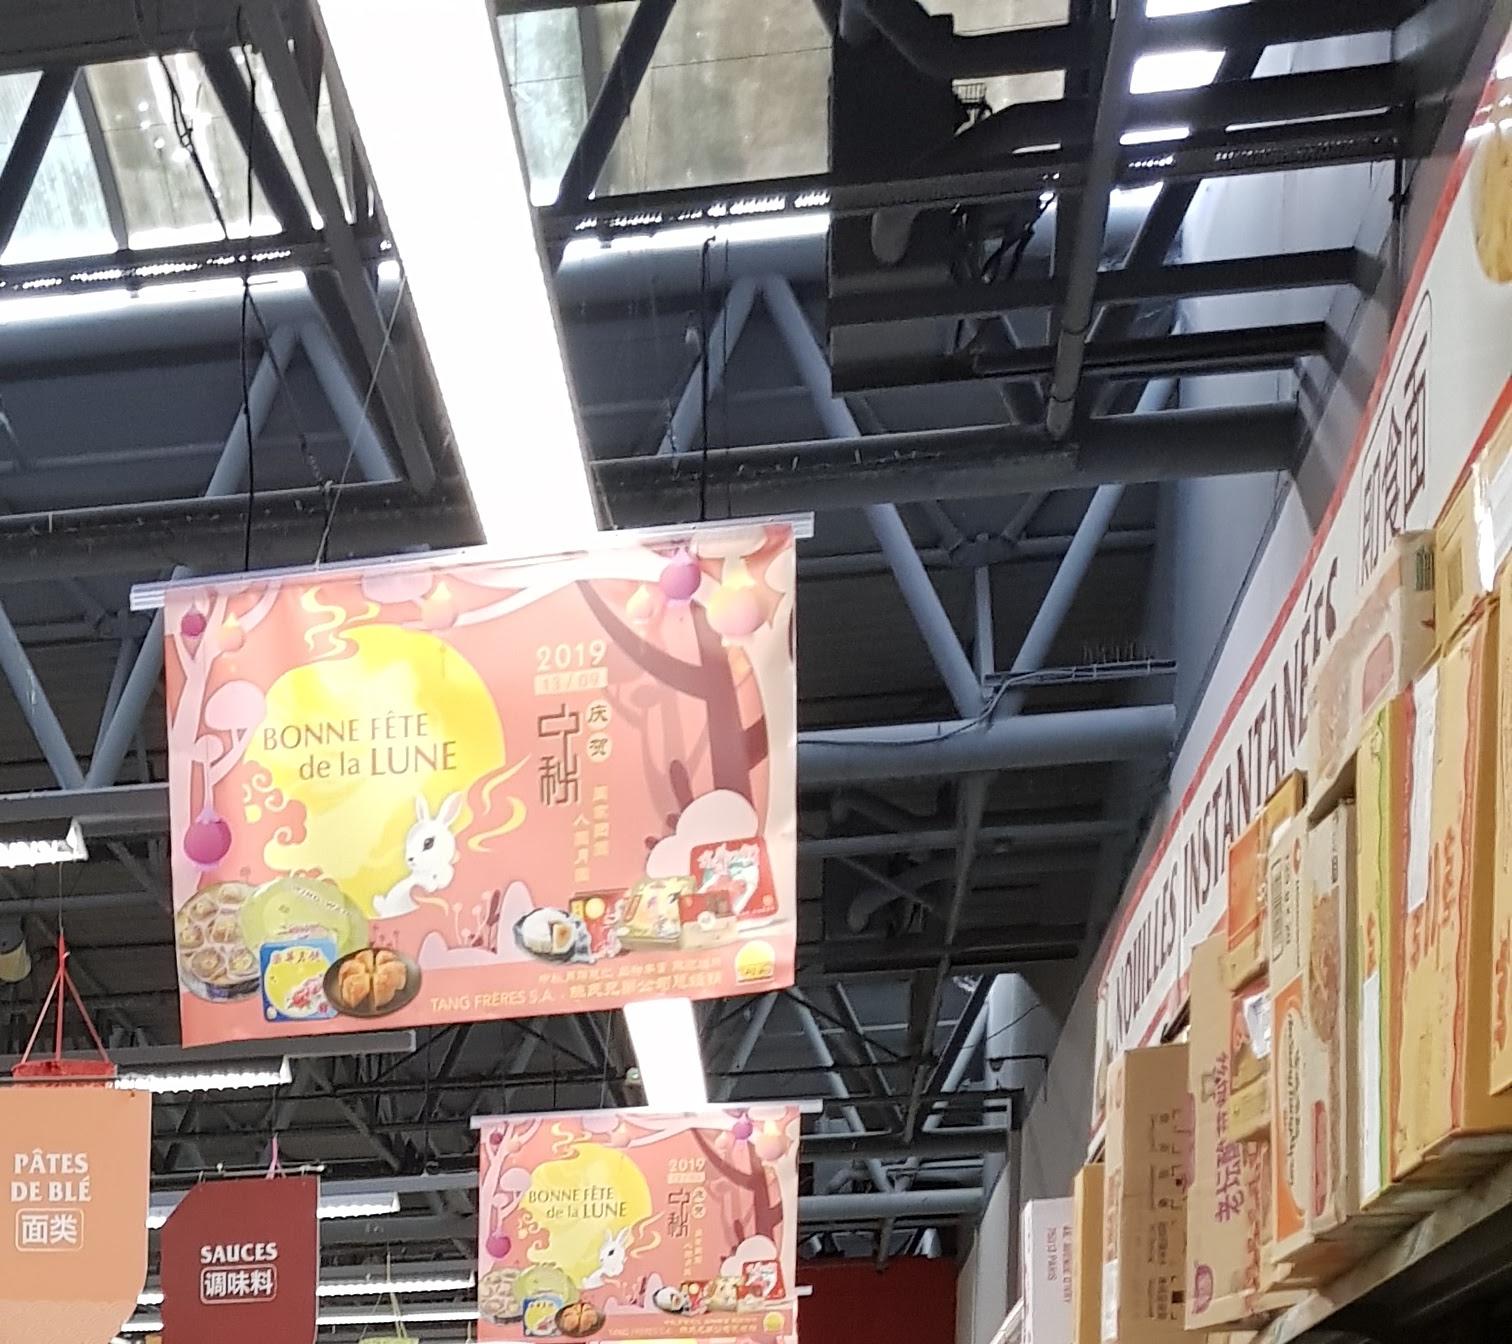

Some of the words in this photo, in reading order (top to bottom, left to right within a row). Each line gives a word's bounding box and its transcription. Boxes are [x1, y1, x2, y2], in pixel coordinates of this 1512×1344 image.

[536, 640, 608, 672] 2019
[262, 717, 361, 752] BONNE
[370, 709, 430, 742] FÊTE
[298, 751, 332, 781] de
[338, 749, 362, 778] la
[371, 741, 458, 778] LUNE
[1115, 860, 1179, 1044] NOUILLES
[431, 994, 472, 1012] TANG
[14, 1147, 89, 1174] PÂTES
[668, 1158, 706, 1172] 2019
[10, 1181, 42, 1202] DE
[48, 1175, 92, 1202] BLÉ
[528, 1186, 579, 1204] BONNE
[583, 1184, 615, 1201] FÊTE
[546, 1204, 564, 1219] de
[567, 1203, 580, 1219] la
[583, 1200, 628, 1219] LUNE
[21, 1213, 78, 1246] 面类
[200, 1242, 278, 1264] SAUCES
[204, 1269, 275, 1298] 调味料
